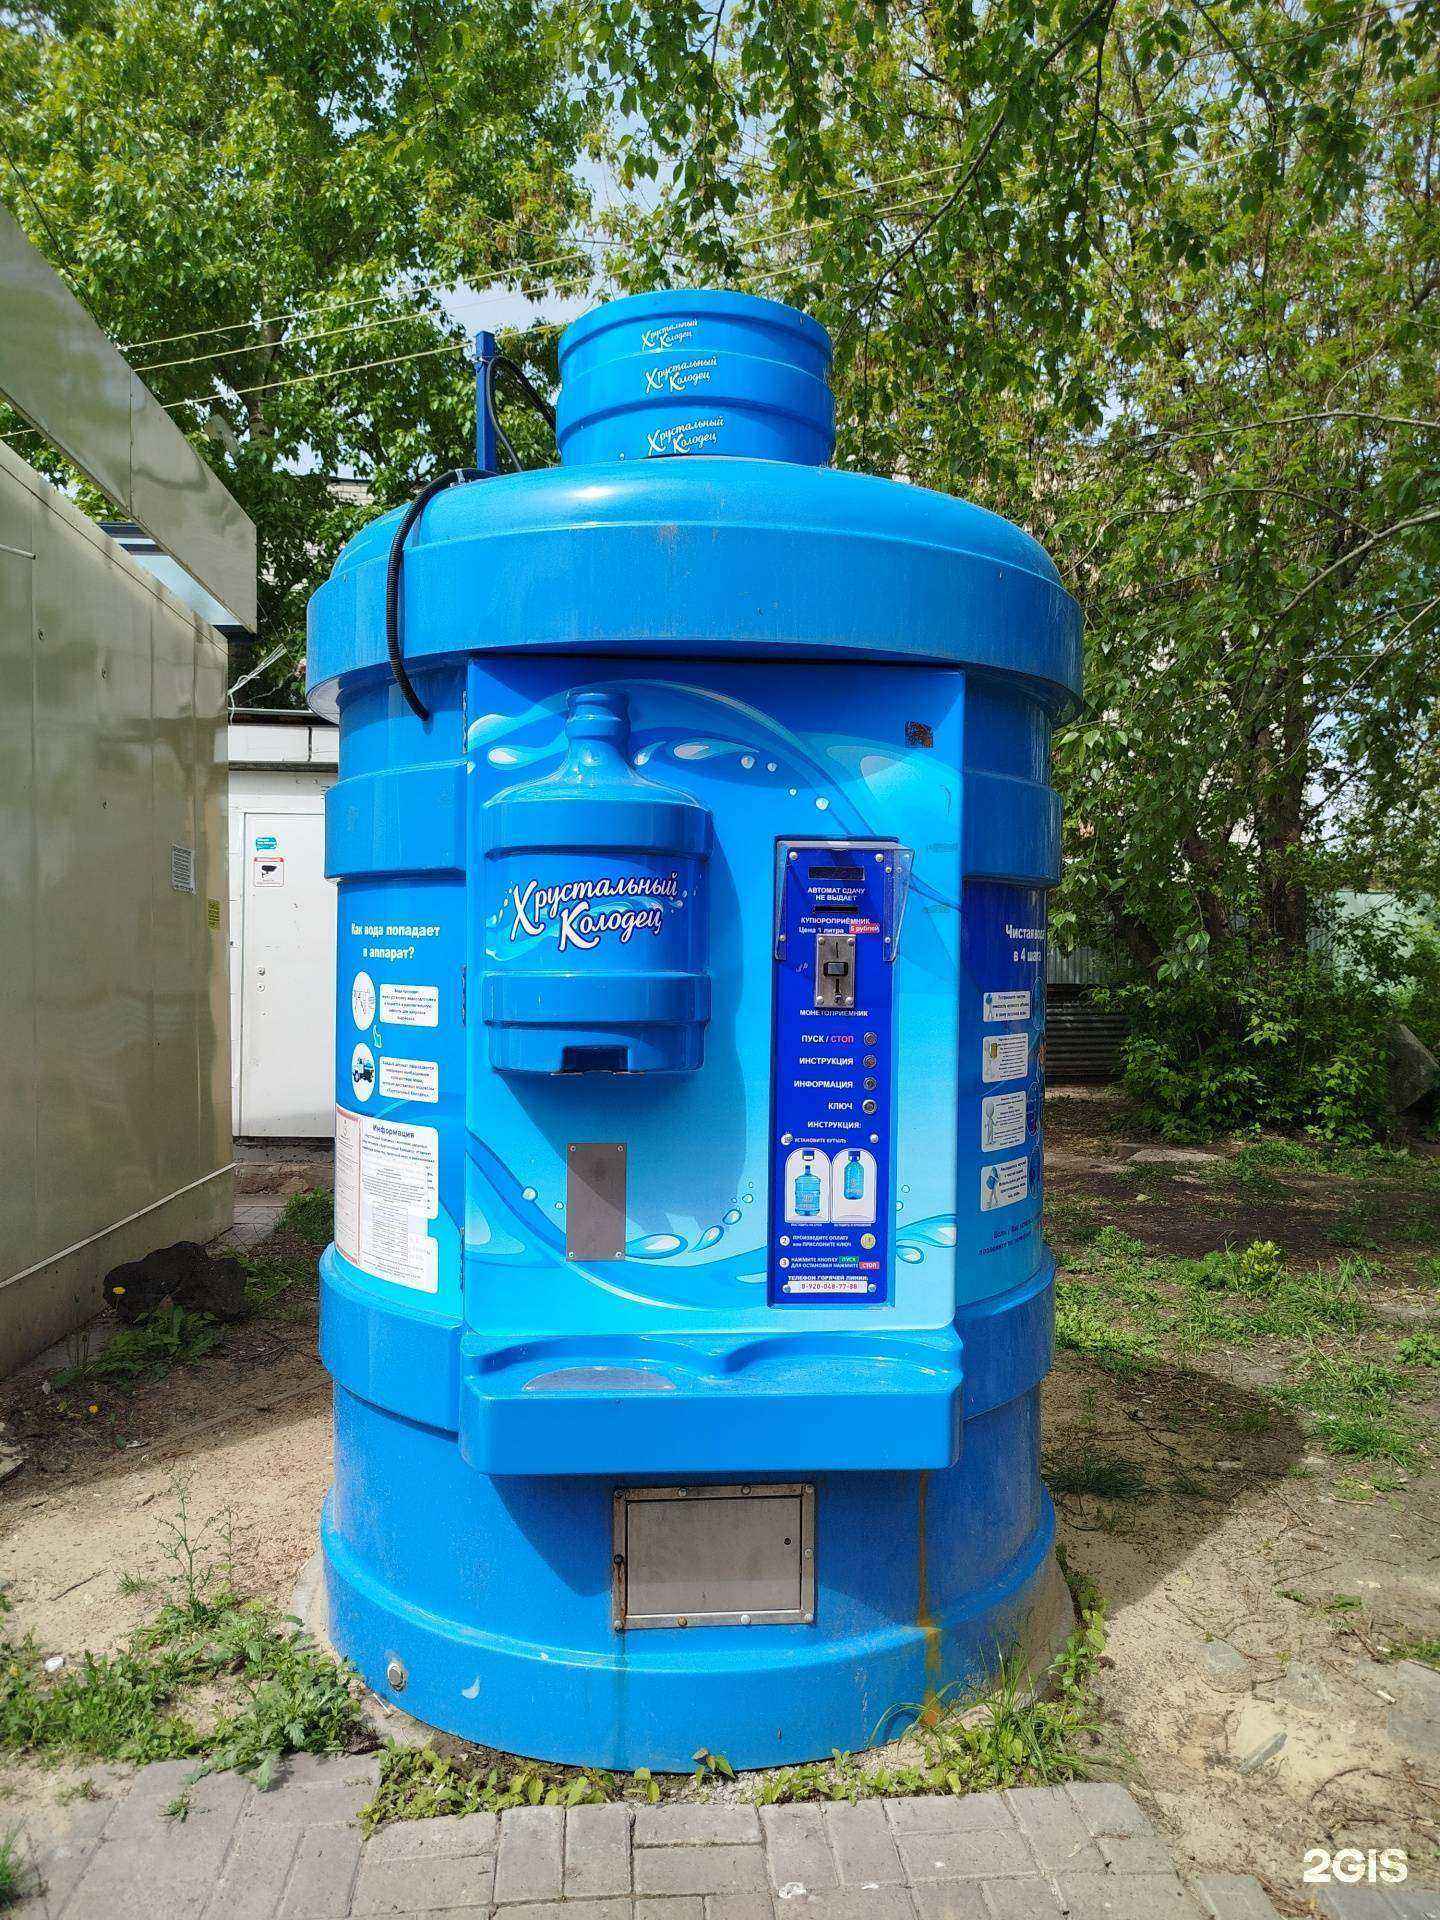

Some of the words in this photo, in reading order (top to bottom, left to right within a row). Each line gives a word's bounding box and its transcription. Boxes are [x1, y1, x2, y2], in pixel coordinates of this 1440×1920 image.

[641, 318, 698, 350] Хрустальный
[659, 331, 693, 350] Колодец
[645, 356, 717, 393] Хрустальный
[669, 371, 711, 392] Колодец
[647, 416, 725, 455] Хрустальный
[672, 431, 717, 454] Колодец
[842, 887, 866, 895] СДАЧУ
[510, 872, 678, 941] Хрустальный
[364, 925, 384, 938] вода
[386, 925, 441, 938] попадает
[558, 901, 662, 951] Колодец
[362, 947, 368, 958] в
[369, 946, 415, 962] аппарат?
[801, 1034, 825, 1043] ПУСК
[830, 1034, 854, 1043] СТОП
[799, 1057, 854, 1066] ИНСТРУКЦИЯ
[793, 1080, 854, 1089] ИНФОРМАЦИЯ
[828, 1102, 853, 1110] КЛЮЧ
[372, 1123, 415, 1139] Информация
[807, 1121, 862, 1129] ИНСТРУКЦИЯ:
